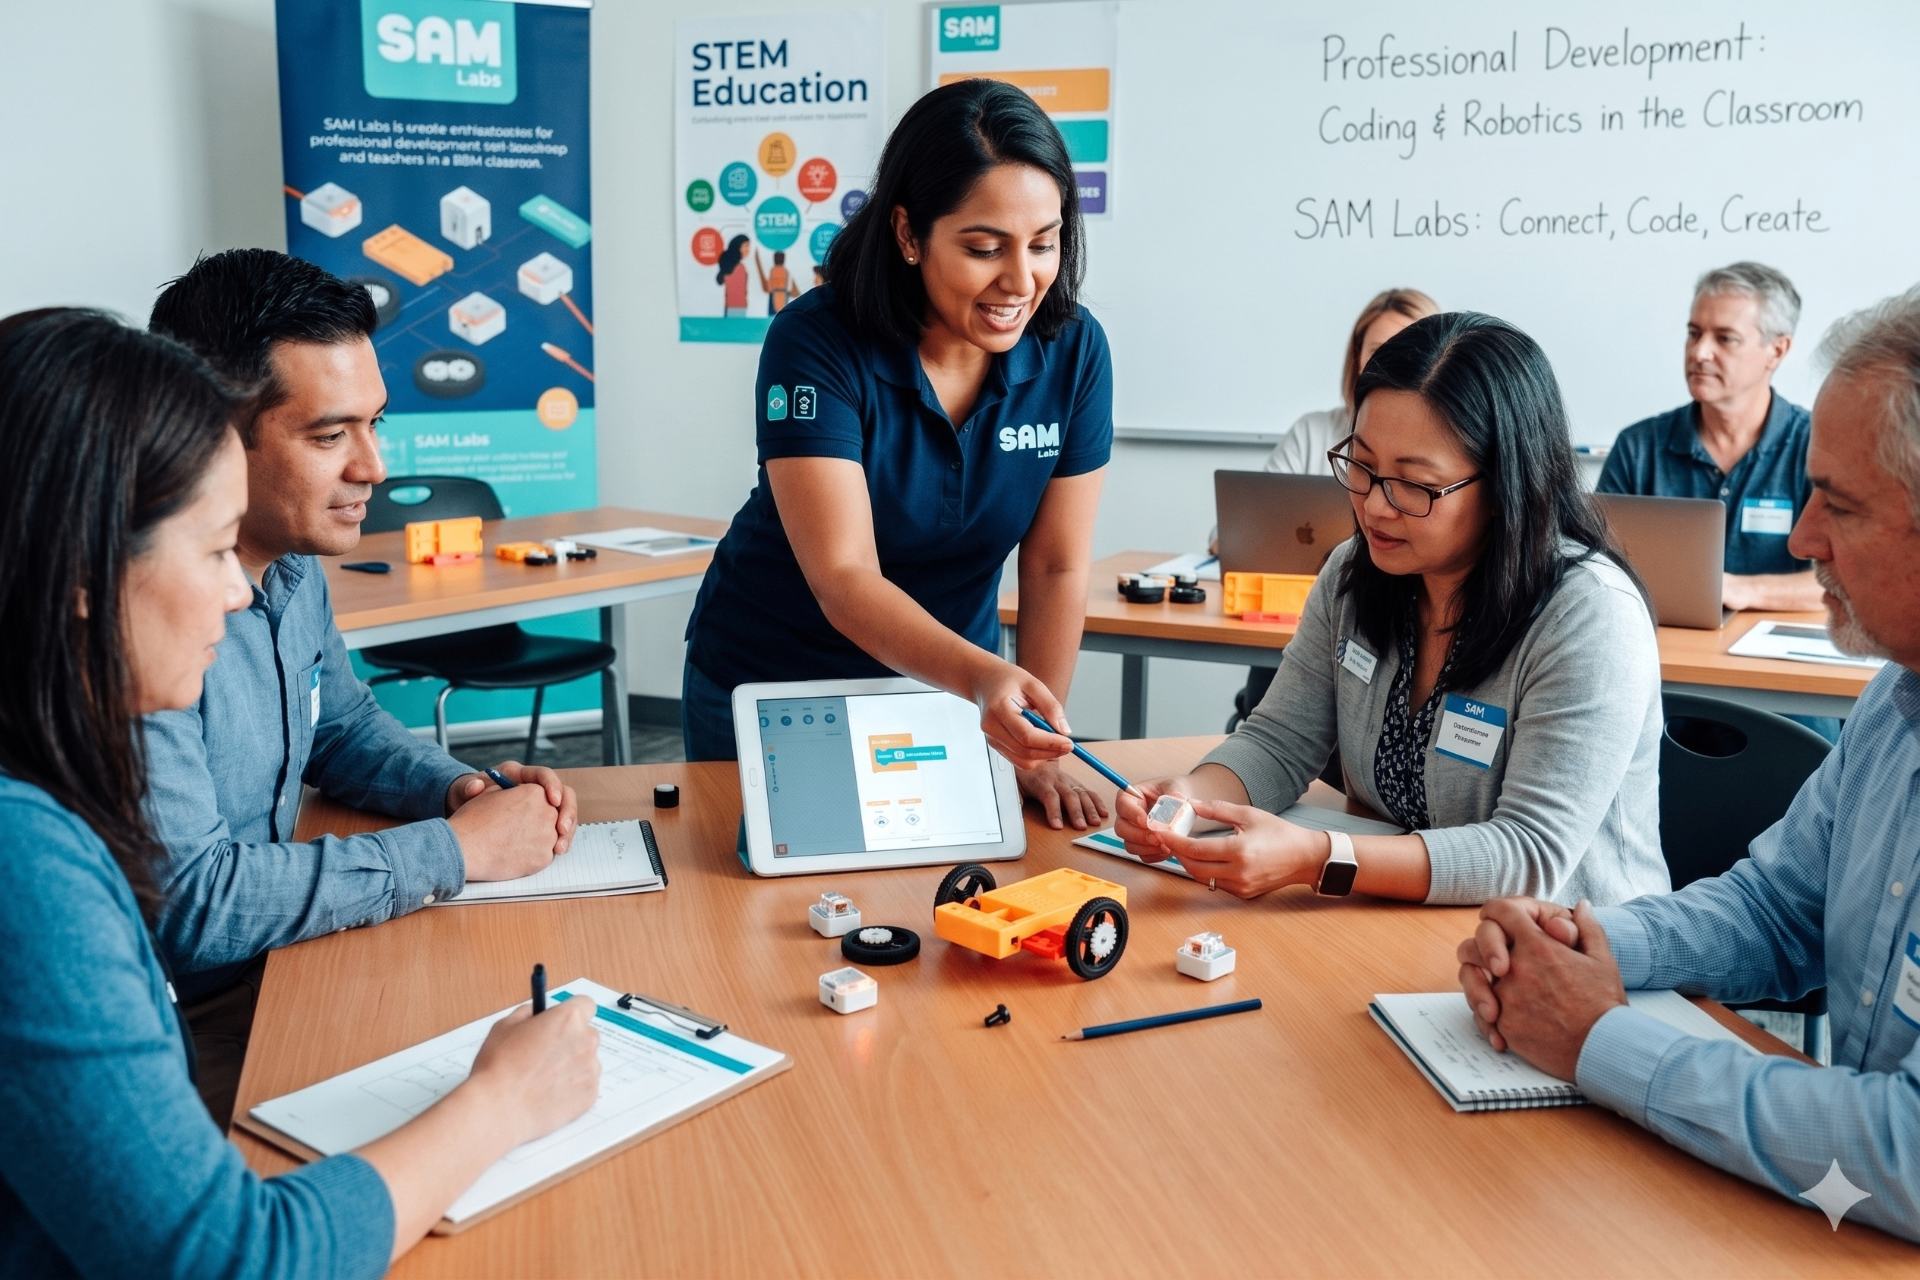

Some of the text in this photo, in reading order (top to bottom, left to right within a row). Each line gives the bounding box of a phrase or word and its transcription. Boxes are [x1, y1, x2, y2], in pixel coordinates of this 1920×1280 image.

[945, 16, 995, 39] SAM
[377, 14, 501, 67] SAM
[1323, 22, 1764, 81] Professional Development:
[692, 40, 788, 72] STEM
[457, 70, 502, 87] Labs
[694, 70, 867, 106] Education
[324, 118, 355, 130] SAM
[358, 120, 390, 133] Labs
[393, 120, 404, 133] is
[535, 126, 553, 139] for
[1319, 90, 1862, 160] Coding & Robotics in the Classroom
[310, 133, 392, 149] professional
[394, 134, 481, 153] development
[339, 151, 366, 163] and
[368, 152, 424, 165] teachers
[427, 151, 441, 165] in
[757, 213, 798, 228] STEM
[1295, 194, 1828, 240] SAM Labs: Connect, Code, Create
[415, 433, 490, 448] SAM Labs
[999, 423, 1060, 452] SAM
[1038, 448, 1059, 458] Labs
[1464, 702, 1485, 718] SAM
